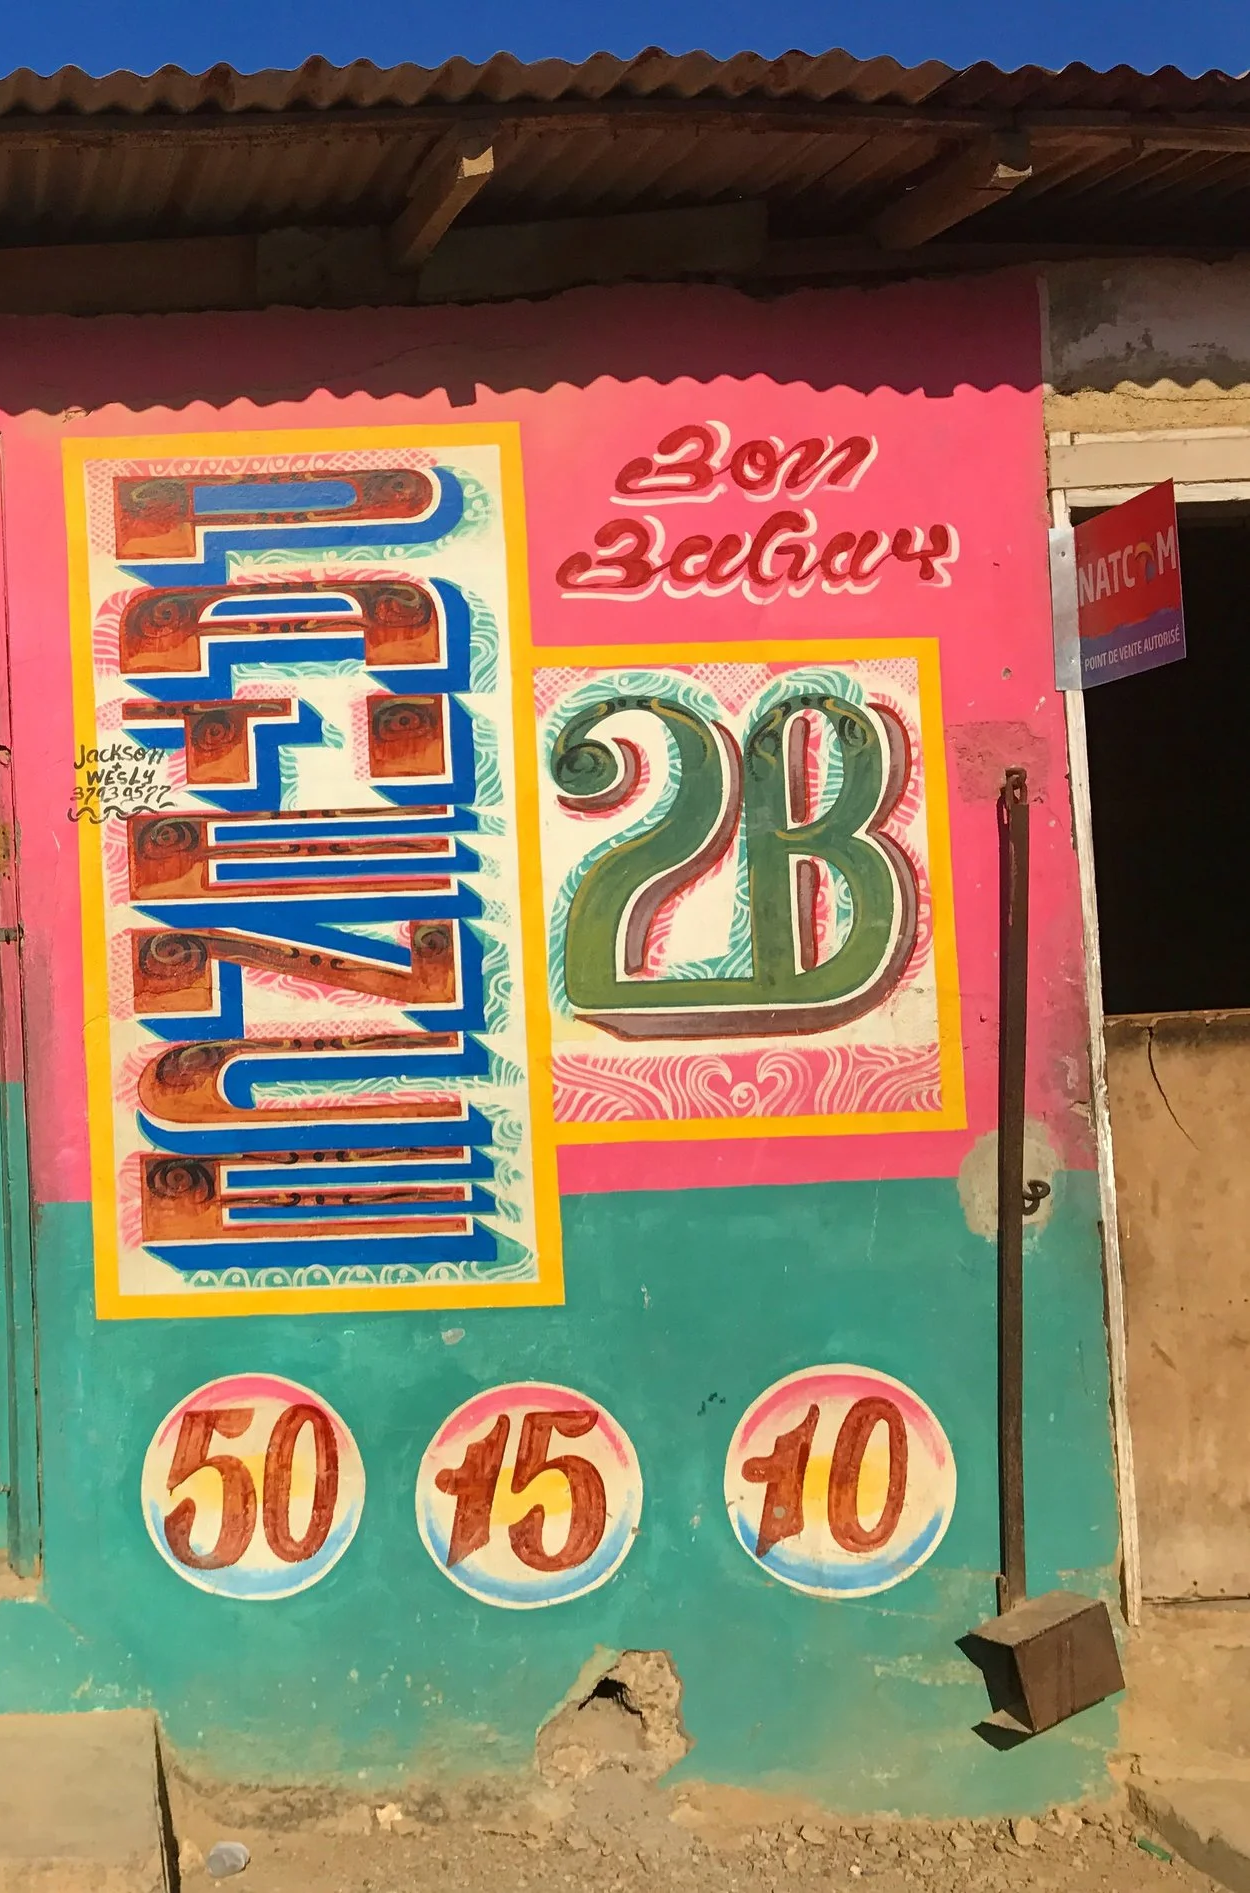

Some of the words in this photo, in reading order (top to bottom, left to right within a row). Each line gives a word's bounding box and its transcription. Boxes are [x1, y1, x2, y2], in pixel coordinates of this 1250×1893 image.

[613, 421, 877, 504] Bon
[1084, 652, 1107, 672] POINT
[1108, 650, 1119, 664] DE
[1119, 640, 1142, 661] VENTE
[1143, 625, 1181, 652] AUTORISÉ
[550, 692, 919, 1042] 2B
[163, 1402, 342, 1570] 50
[435, 1410, 608, 1572] 15
[741, 1395, 909, 1559] 10
